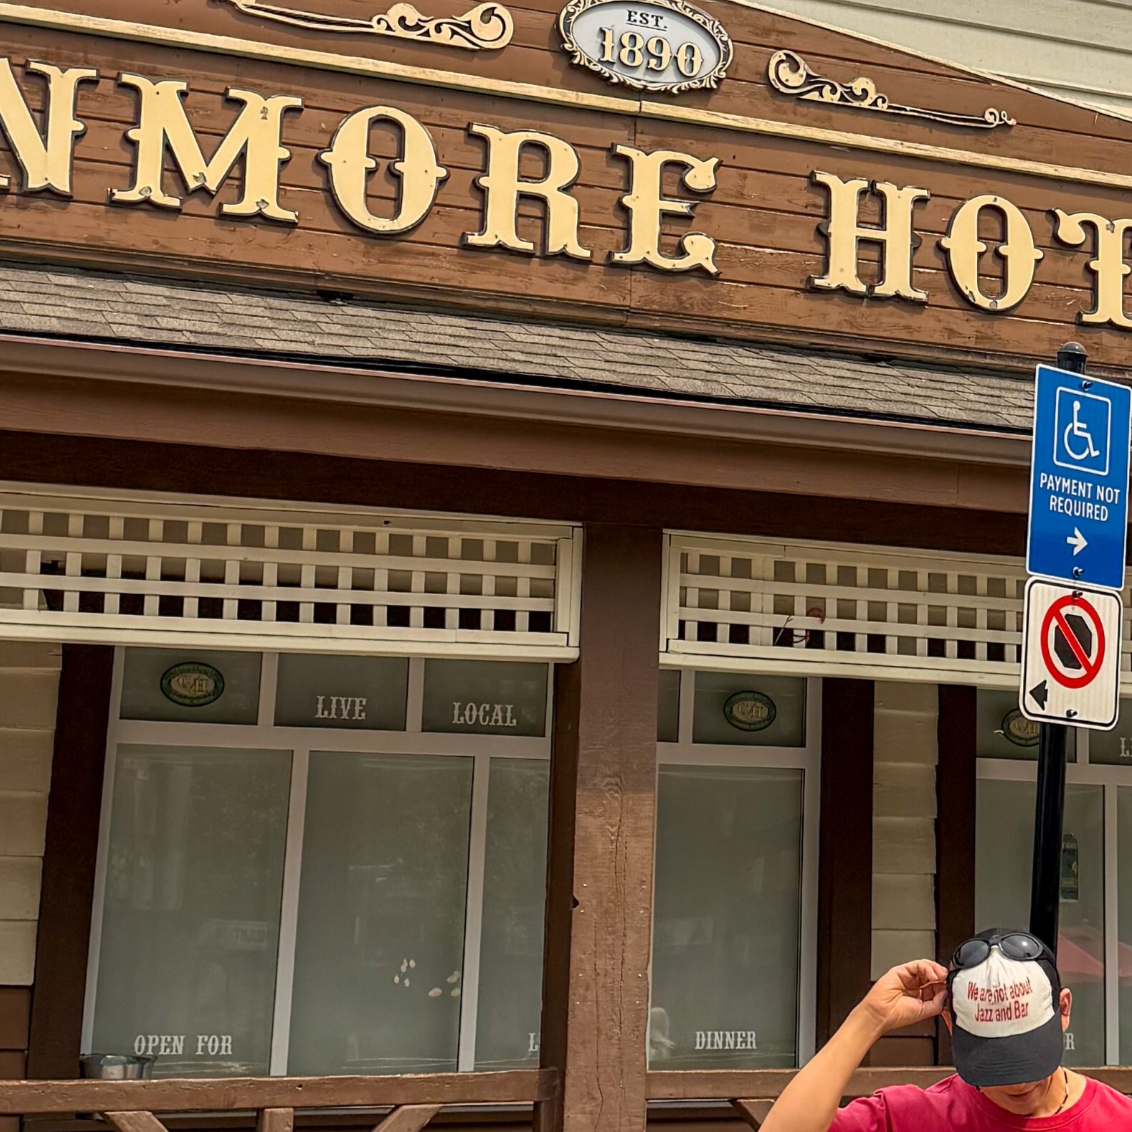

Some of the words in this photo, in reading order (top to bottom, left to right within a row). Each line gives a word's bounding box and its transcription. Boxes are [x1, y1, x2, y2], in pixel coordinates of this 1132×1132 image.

[626, 9, 668, 29] EST.
[599, 26, 704, 77] 1890
[1039, 472, 1093, 499] PAYMENT
[1096, 485, 1121, 505] NOT
[1049, 494, 1109, 522] REQUIRED
[315, 695, 367, 720] LIVE
[452, 702, 517, 727] LOCAL
[967, 981, 979, 1001] We
[979, 985, 993, 1002] are
[993, 984, 1009, 1004] not
[1010, 976, 1033, 1000] about
[974, 1003, 994, 1022] Jazz
[995, 1002, 1012, 1021] and
[1014, 1000, 1029, 1020] Bar
[133, 1034, 186, 1055] OPEN
[195, 1034, 233, 1055] FOR
[694, 1031, 757, 1050] DINNER
